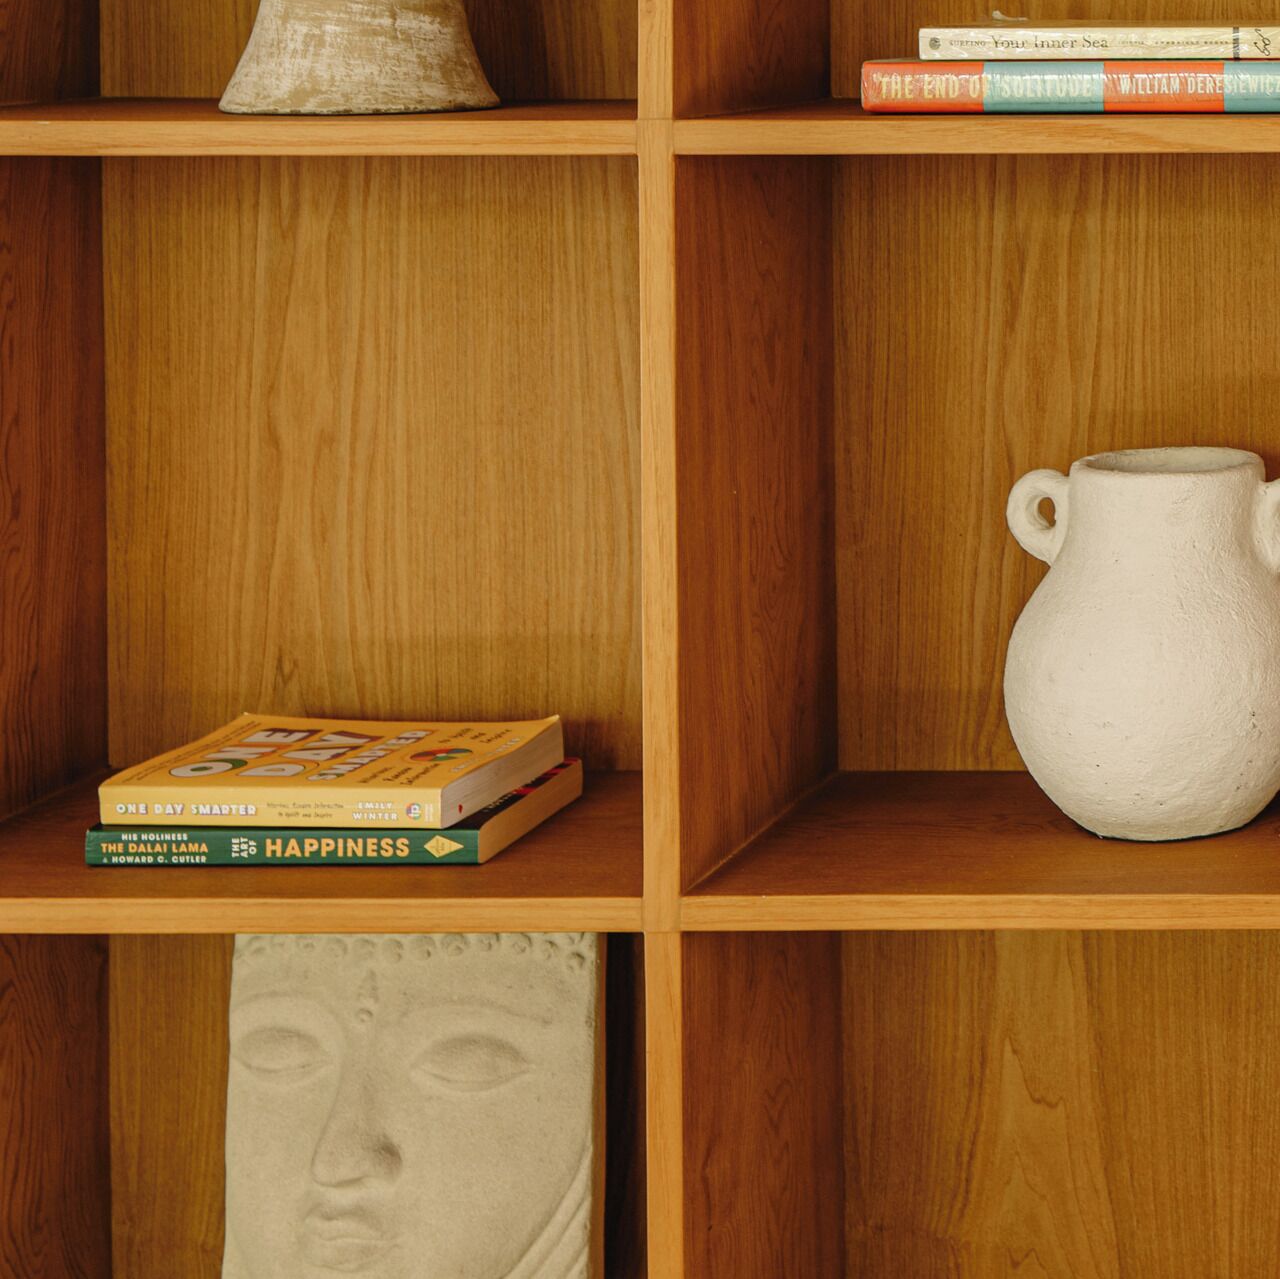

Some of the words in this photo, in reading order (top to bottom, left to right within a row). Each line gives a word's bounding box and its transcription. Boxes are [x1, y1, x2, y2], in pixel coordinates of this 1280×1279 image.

[1034, 35, 1078, 49] Inner
[1082, 34, 1109, 49] Sea
[923, 74, 959, 100] END
[1001, 75, 1093, 99] SOLITUDE
[1119, 74, 1181, 95] WILLIAM
[169, 728, 320, 778] ONE
[237, 730, 378, 777] DAY
[116, 803, 148, 815] ONE
[154, 803, 184, 816] DAY
[191, 803, 257, 816] SMARTER
[357, 801, 393, 810] EMILY
[352, 812, 399, 821] WINTER
[121, 833, 136, 841] HIS
[140, 833, 188, 841] HOLINESS
[101, 842, 125, 853] THE
[128, 842, 167, 854] DALAI
[171, 842, 209, 853] LAMA
[231, 837, 241, 858] THE
[240, 836, 250, 859] ART
[249, 839, 257, 855] OF
[265, 837, 410, 858] HAPPINESS
[111, 855, 154, 864] HOWARD
[156, 856, 169, 864] C.
[171, 855, 207, 864] CUTLER
